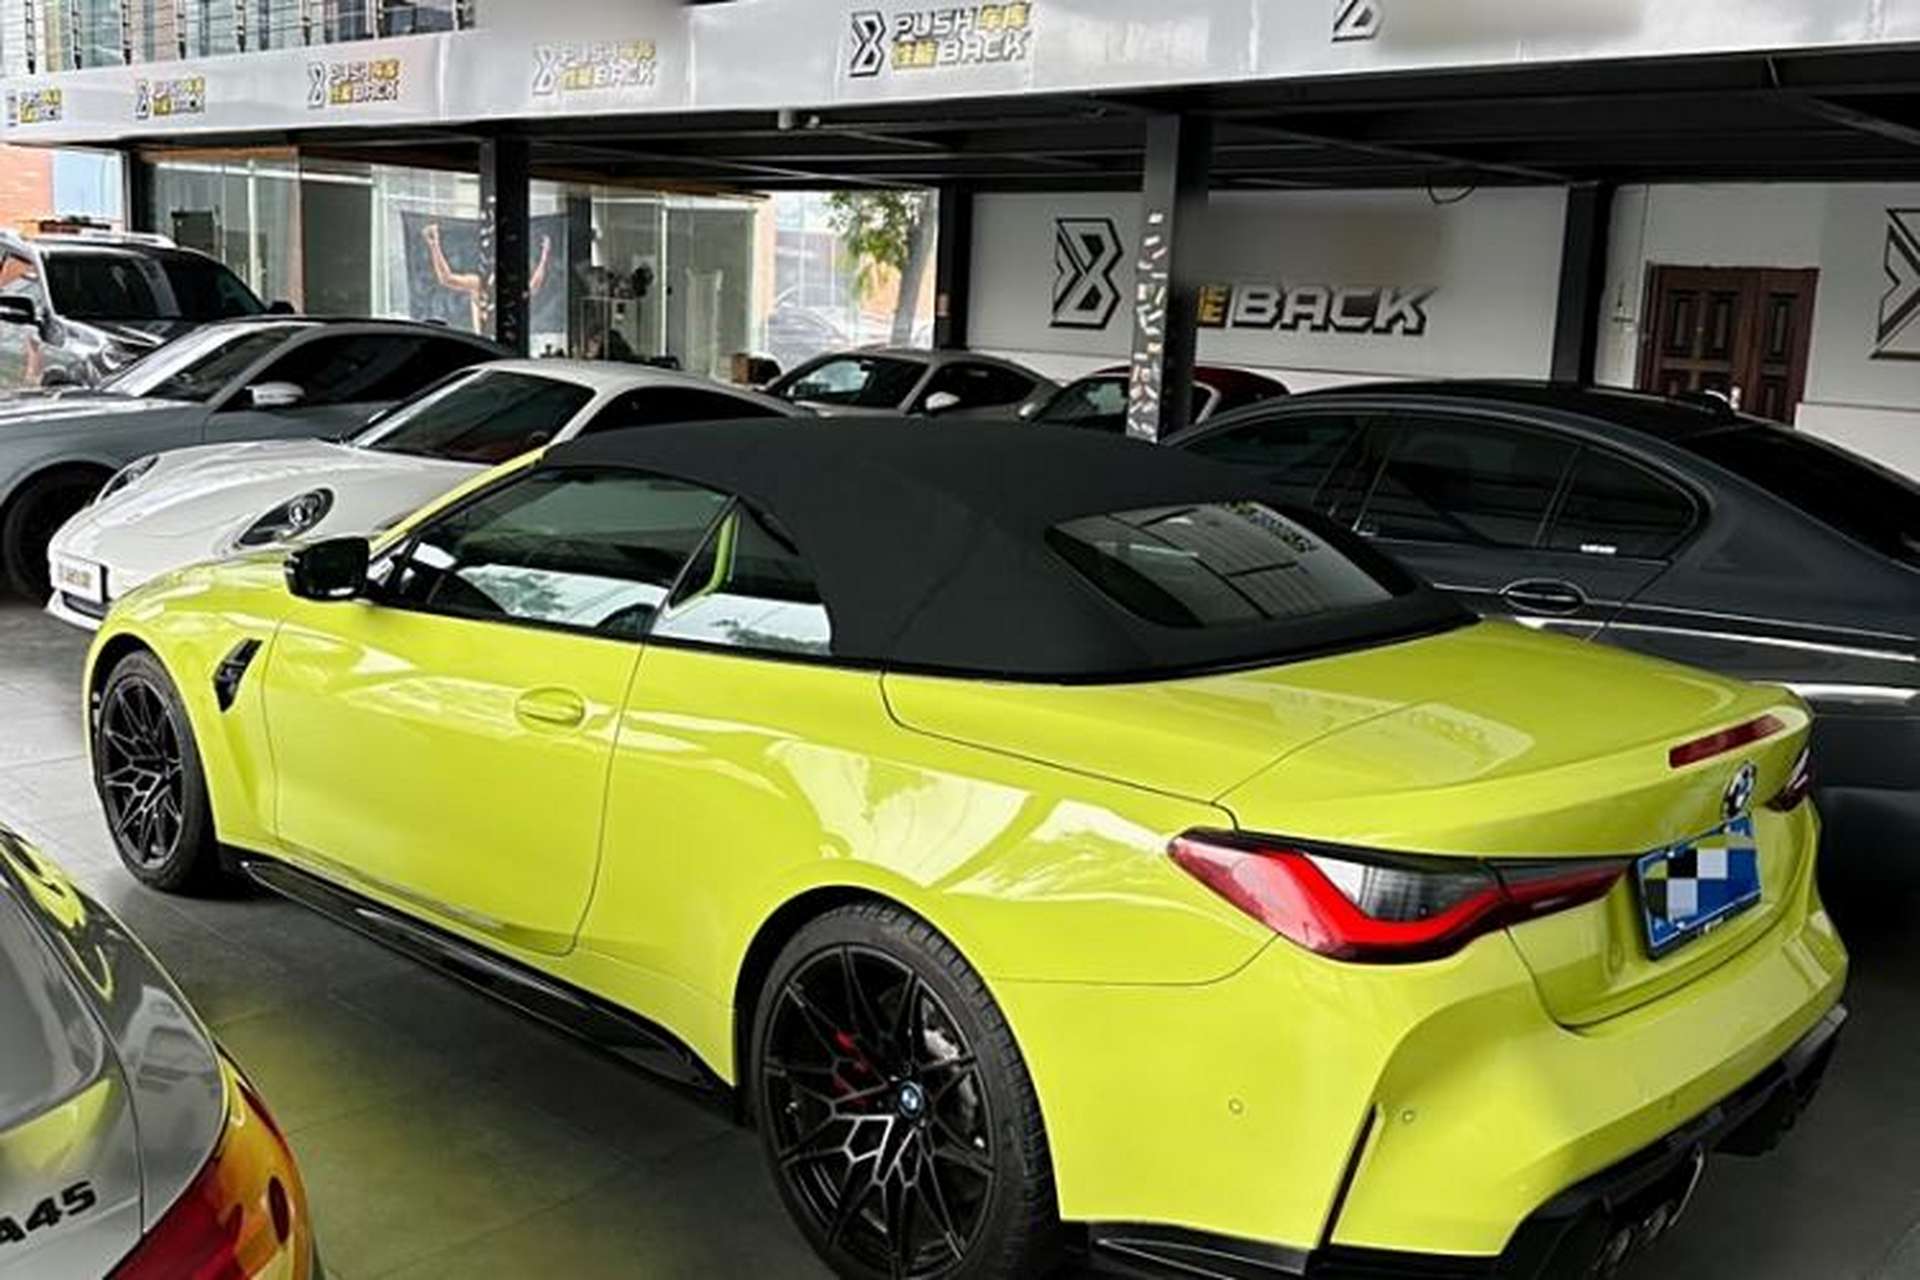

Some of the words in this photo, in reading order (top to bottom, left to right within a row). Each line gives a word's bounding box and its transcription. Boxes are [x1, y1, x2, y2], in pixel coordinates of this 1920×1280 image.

[892, 7, 978, 42] PUSH
[940, 31, 1031, 65] BACK
[1230, 284, 1437, 335] BACK
[0, 1181, 96, 1244] A45
